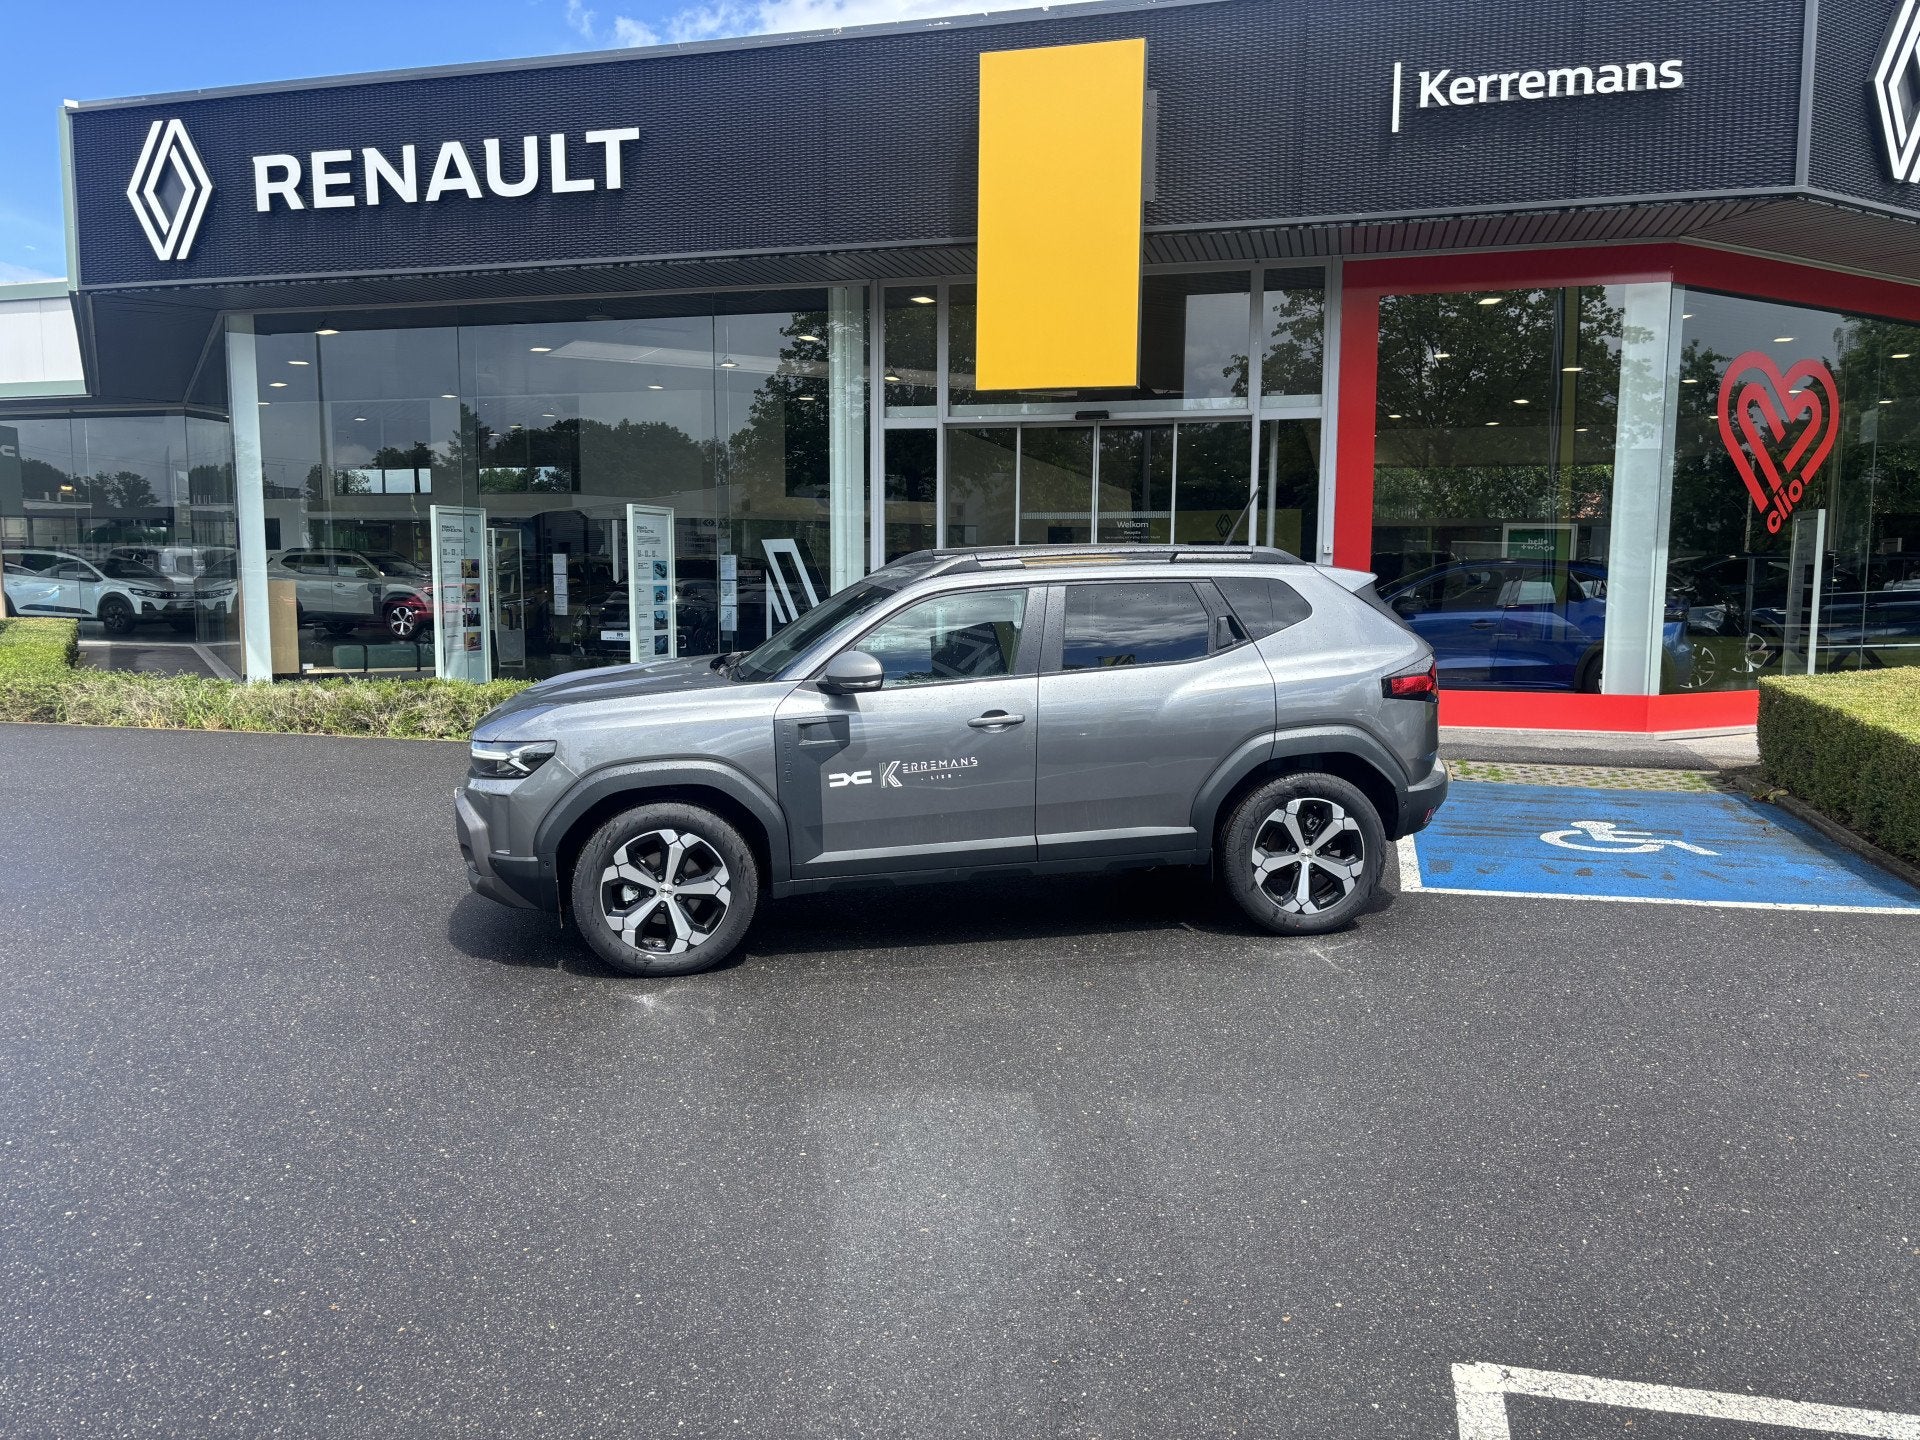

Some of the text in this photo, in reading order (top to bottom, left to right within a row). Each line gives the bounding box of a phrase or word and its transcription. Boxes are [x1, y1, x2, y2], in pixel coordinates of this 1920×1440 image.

[1418, 59, 1684, 108] Kerremans
[252, 127, 640, 212] RENAULT
[1116, 520, 1149, 529] Welkom
[1766, 479, 1803, 534] clio
[1527, 537, 1549, 545] hello
